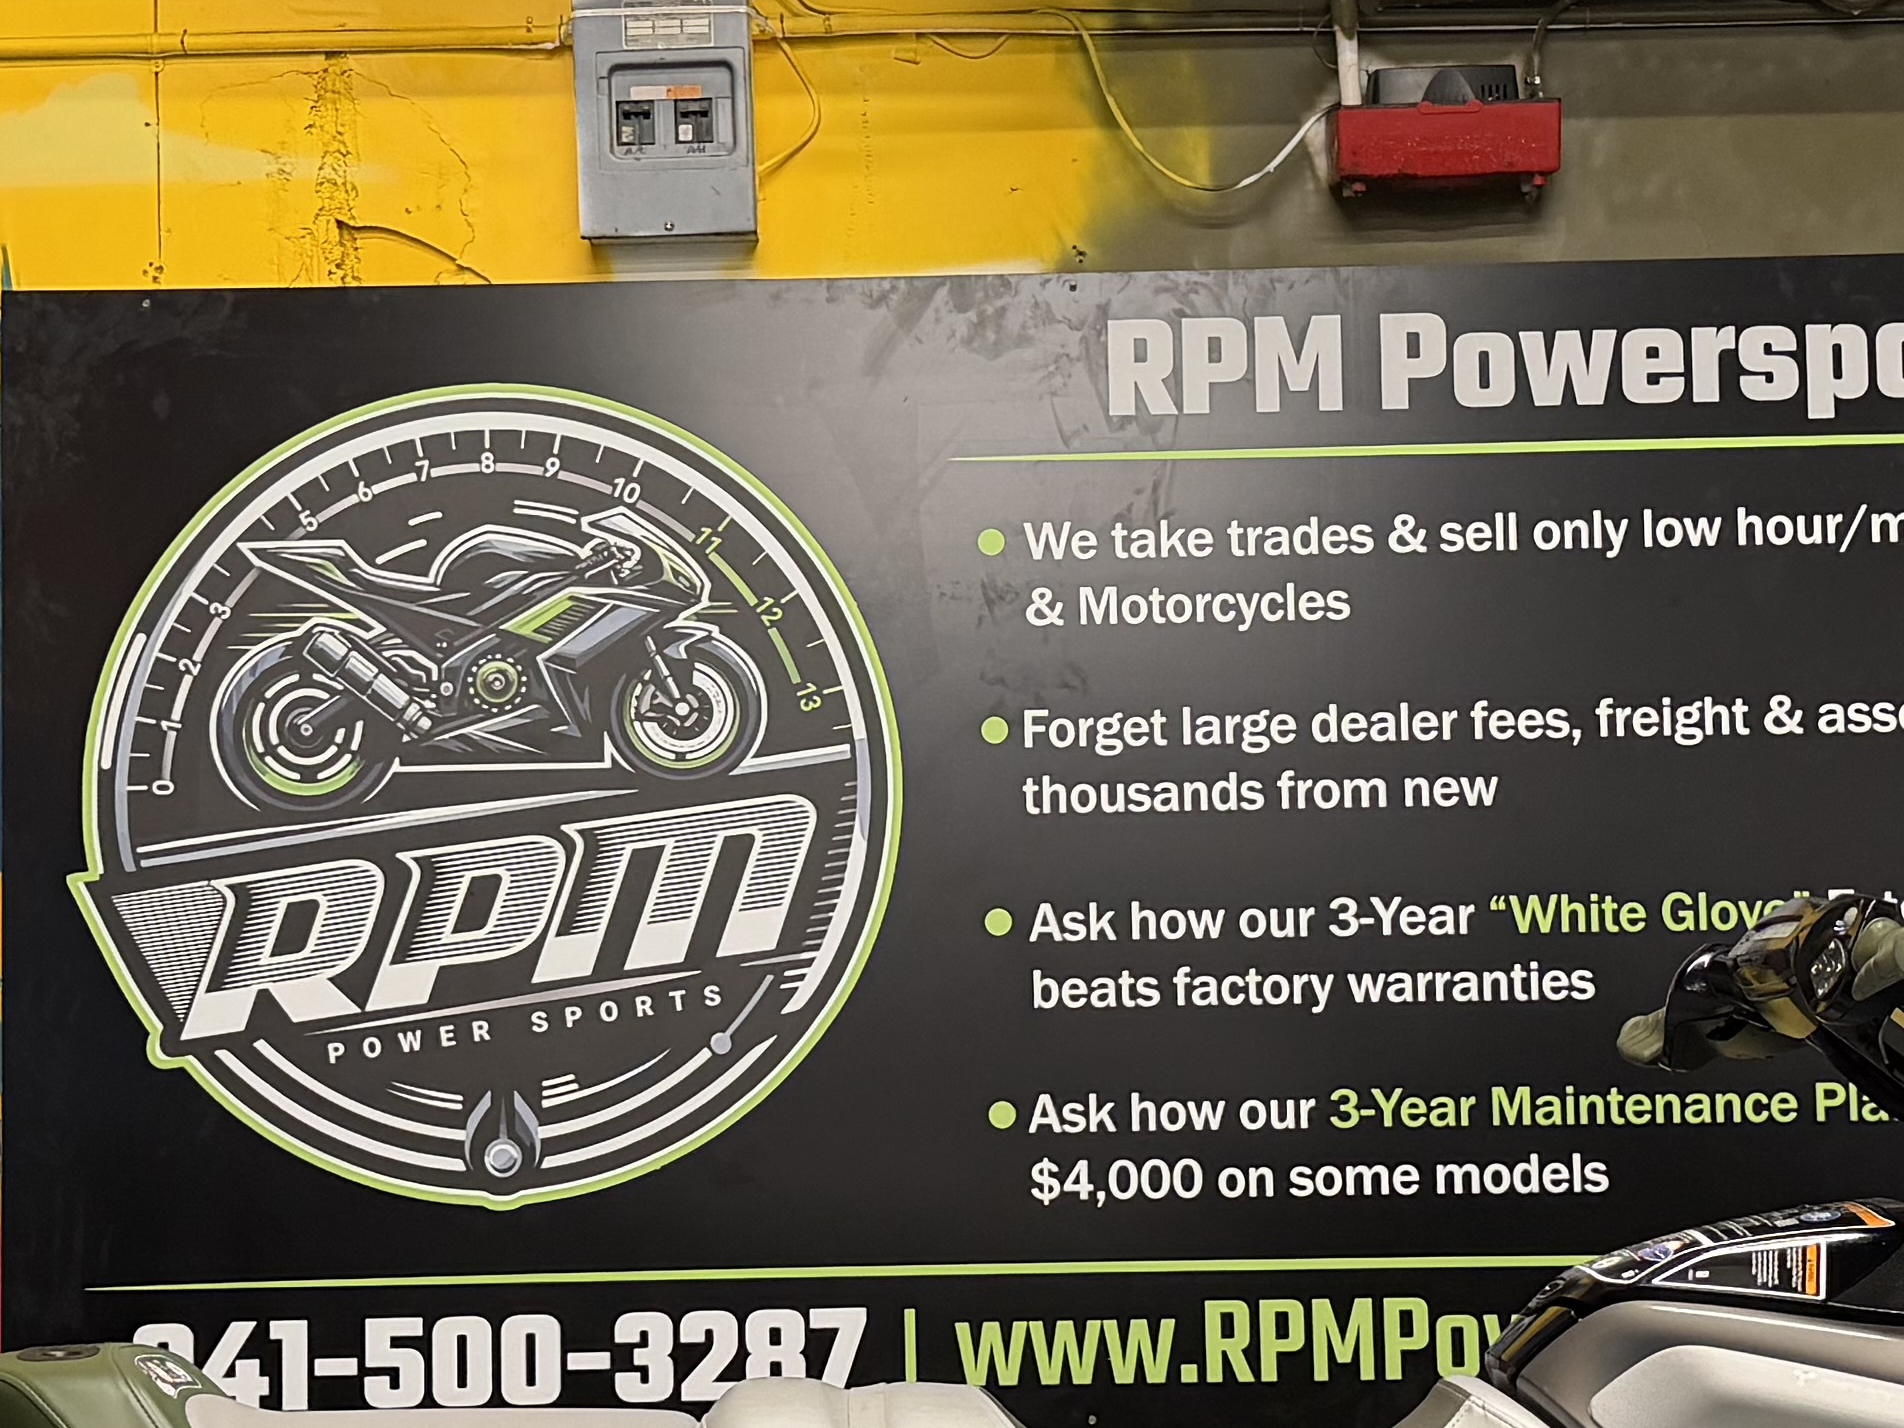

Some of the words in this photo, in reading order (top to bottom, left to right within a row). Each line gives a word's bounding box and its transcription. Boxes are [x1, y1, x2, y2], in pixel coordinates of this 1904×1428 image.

[1107, 315, 1343, 416] RPM
[415, 460, 430, 482] 7
[480, 452, 495, 474] 8
[545, 457, 560, 478] 9
[357, 481, 373, 502] 6
[612, 477, 641, 504] 10
[299, 509, 318, 532] 5
[1024, 521, 1098, 561] We
[1111, 520, 1214, 558] take
[1227, 515, 1375, 557] trades
[1387, 512, 1428, 555] &
[1439, 510, 1519, 552] sell
[1532, 507, 1628, 558] only
[1643, 508, 1722, 547] low
[696, 527, 722, 555] 11
[209, 602, 232, 619] 3
[756, 596, 783, 627] 12
[1026, 586, 1065, 627] &
[1079, 582, 1352, 632] Motorcycles
[178, 658, 201, 676] 2
[796, 682, 822, 712] 13
[160, 720, 182, 731] 1
[1023, 708, 1168, 757] Forget
[1182, 705, 1298, 754] large
[1311, 702, 1458, 744] dealer
[1470, 700, 1582, 746] fees,
[1595, 696, 1750, 746] freight
[1764, 695, 1804, 735] &
[152, 780, 175, 795] 0
[1023, 774, 1265, 816] thousands
[1276, 770, 1388, 811] from
[1403, 774, 1499, 809] new
[181, 794, 818, 1040] RPM
[1029, 902, 1117, 943] Ask
[1130, 899, 1225, 940] how
[1239, 905, 1315, 938] our
[1328, 895, 1476, 939] 3-Year
[1488, 893, 1647, 935] “White
[1032, 969, 1162, 1010] beats
[1172, 966, 1335, 1013] factory
[1347, 962, 1596, 1005] warranties
[327, 1020, 492, 1064] POWER
[530, 985, 723, 1033] SPORTS
[1029, 1093, 1117, 1133] Ask
[1130, 1091, 1225, 1132] how
[1239, 1096, 1316, 1130] our
[1328, 1087, 1477, 1130] 3-Year
[1491, 1083, 1799, 1127] Maintenance
[1814, 1080, 1896, 1123] Pla
[1030, 1156, 1204, 1208] $4,000
[1217, 1164, 1274, 1199] on
[1289, 1162, 1420, 1198] some
[1434, 1152, 1610, 1195] models
